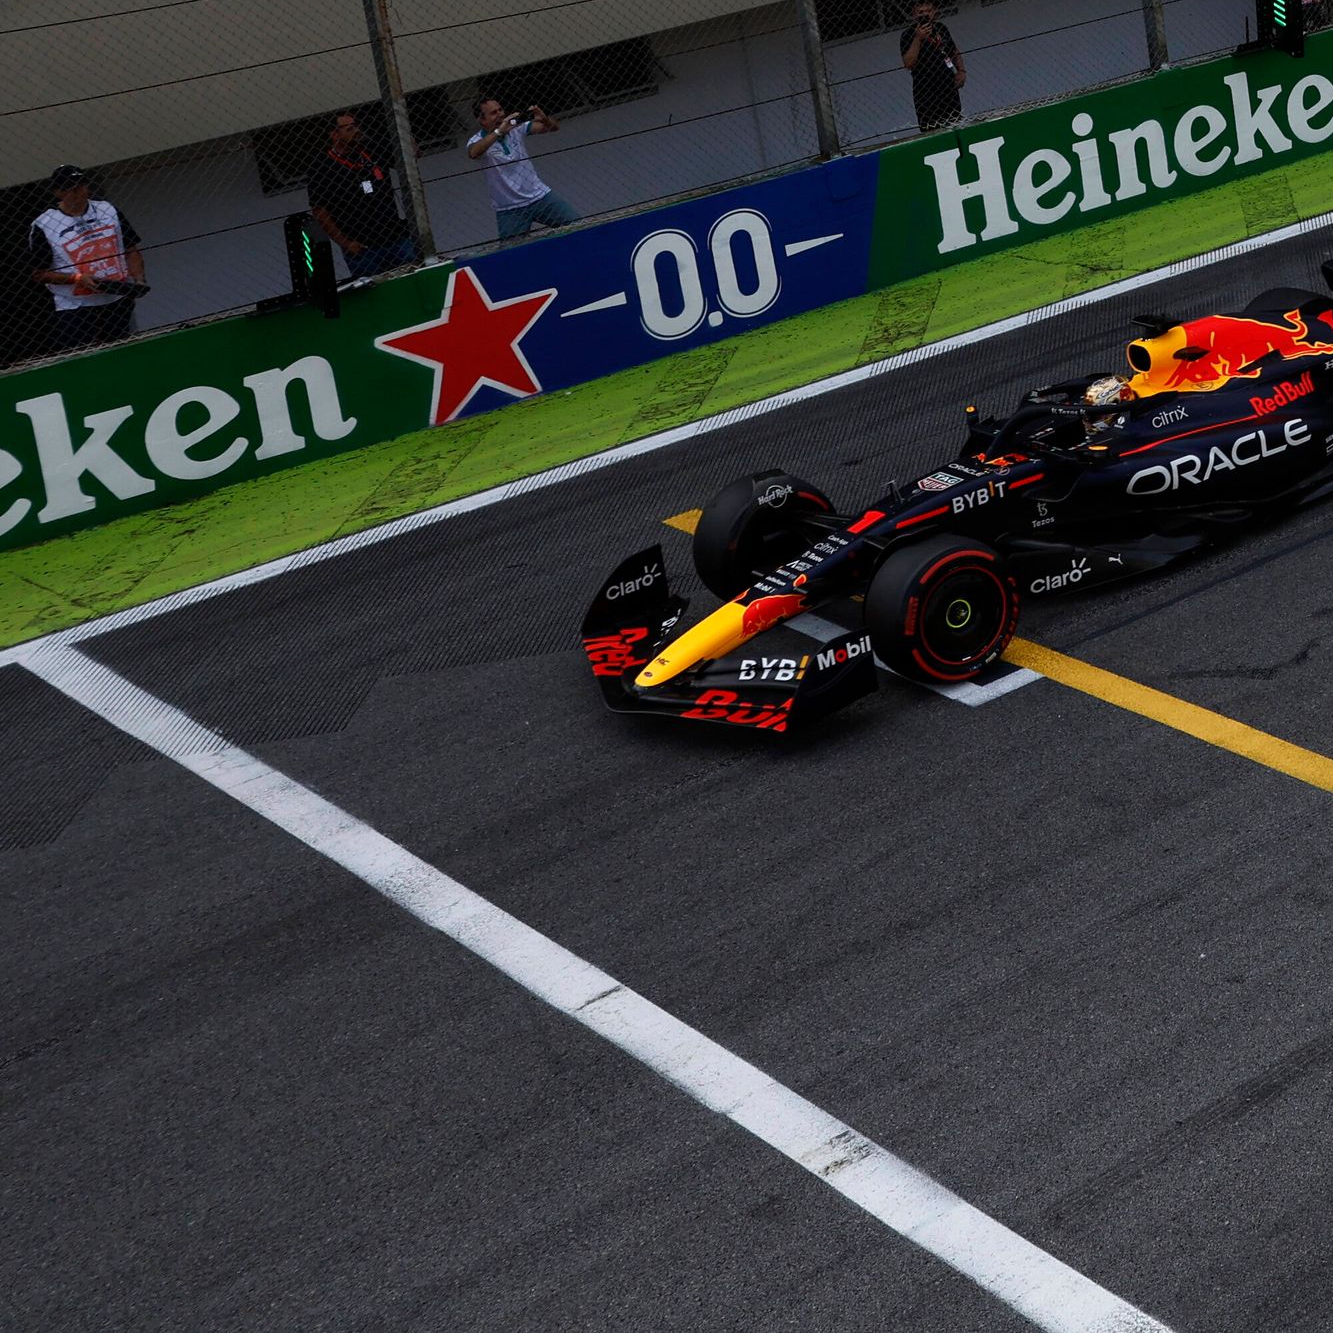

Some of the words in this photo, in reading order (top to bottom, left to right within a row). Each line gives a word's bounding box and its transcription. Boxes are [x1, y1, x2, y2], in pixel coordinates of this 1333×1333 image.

[630, 208, 782, 341] 0.0
[1152, 405, 1189, 429] citrix
[948, 463, 984, 478] ORACLE
[1126, 417, 1312, 496] ORACLE
[933, 472, 958, 484] TAG
[758, 493, 776, 507] Hard
[775, 483, 794, 499] Rock
[951, 481, 1007, 515] BYBIT
[846, 509, 887, 535] 1
[1031, 516, 1055, 529] Tezos
[605, 569, 655, 601] Claro
[1029, 566, 1083, 594] Claro
[817, 633, 872, 672] Mobil
[738, 654, 810, 682] BYBI
